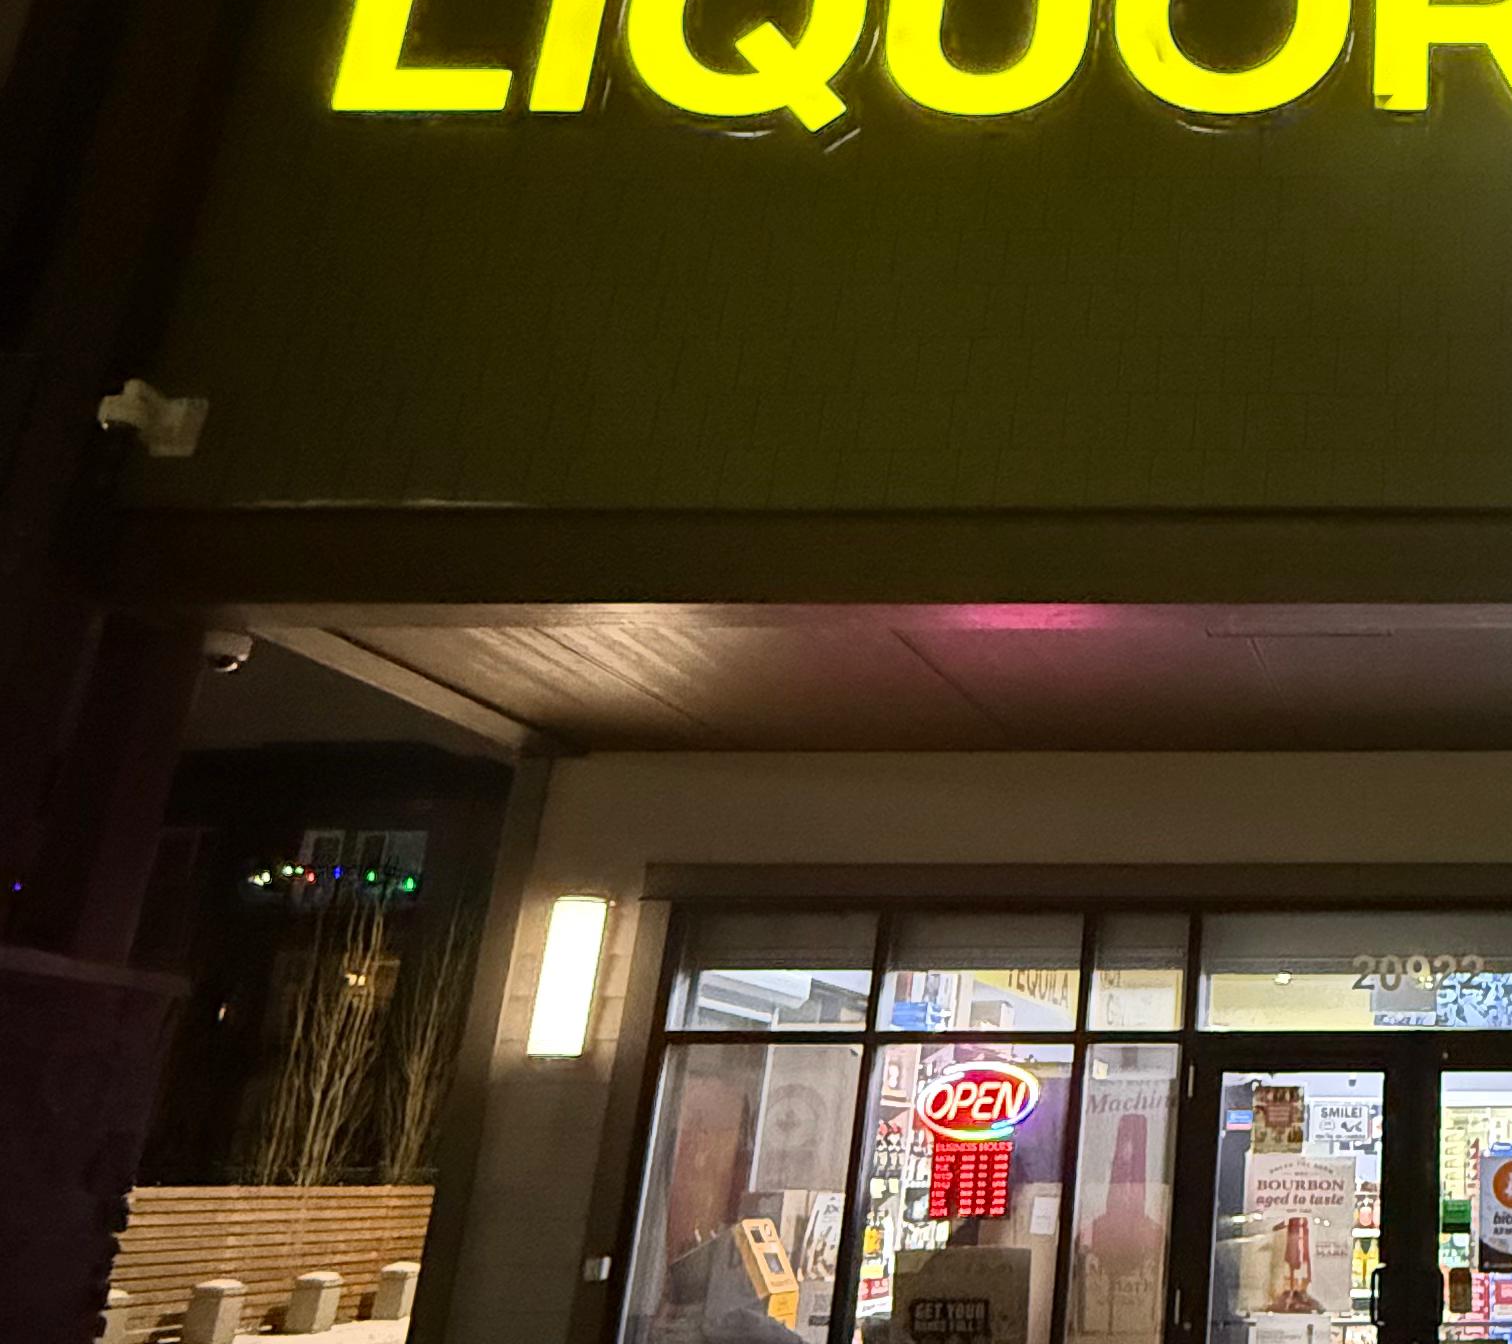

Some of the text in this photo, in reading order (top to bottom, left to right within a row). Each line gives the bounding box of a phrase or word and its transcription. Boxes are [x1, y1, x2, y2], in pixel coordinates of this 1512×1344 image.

[1351, 955, 1485, 992] 20922
[925, 1081, 1026, 1122] OPEN
[1320, 1107, 1362, 1119] SMILE!
[1256, 1179, 1345, 1191] BOURBON
[1256, 1192, 1345, 1208] aged to taste
